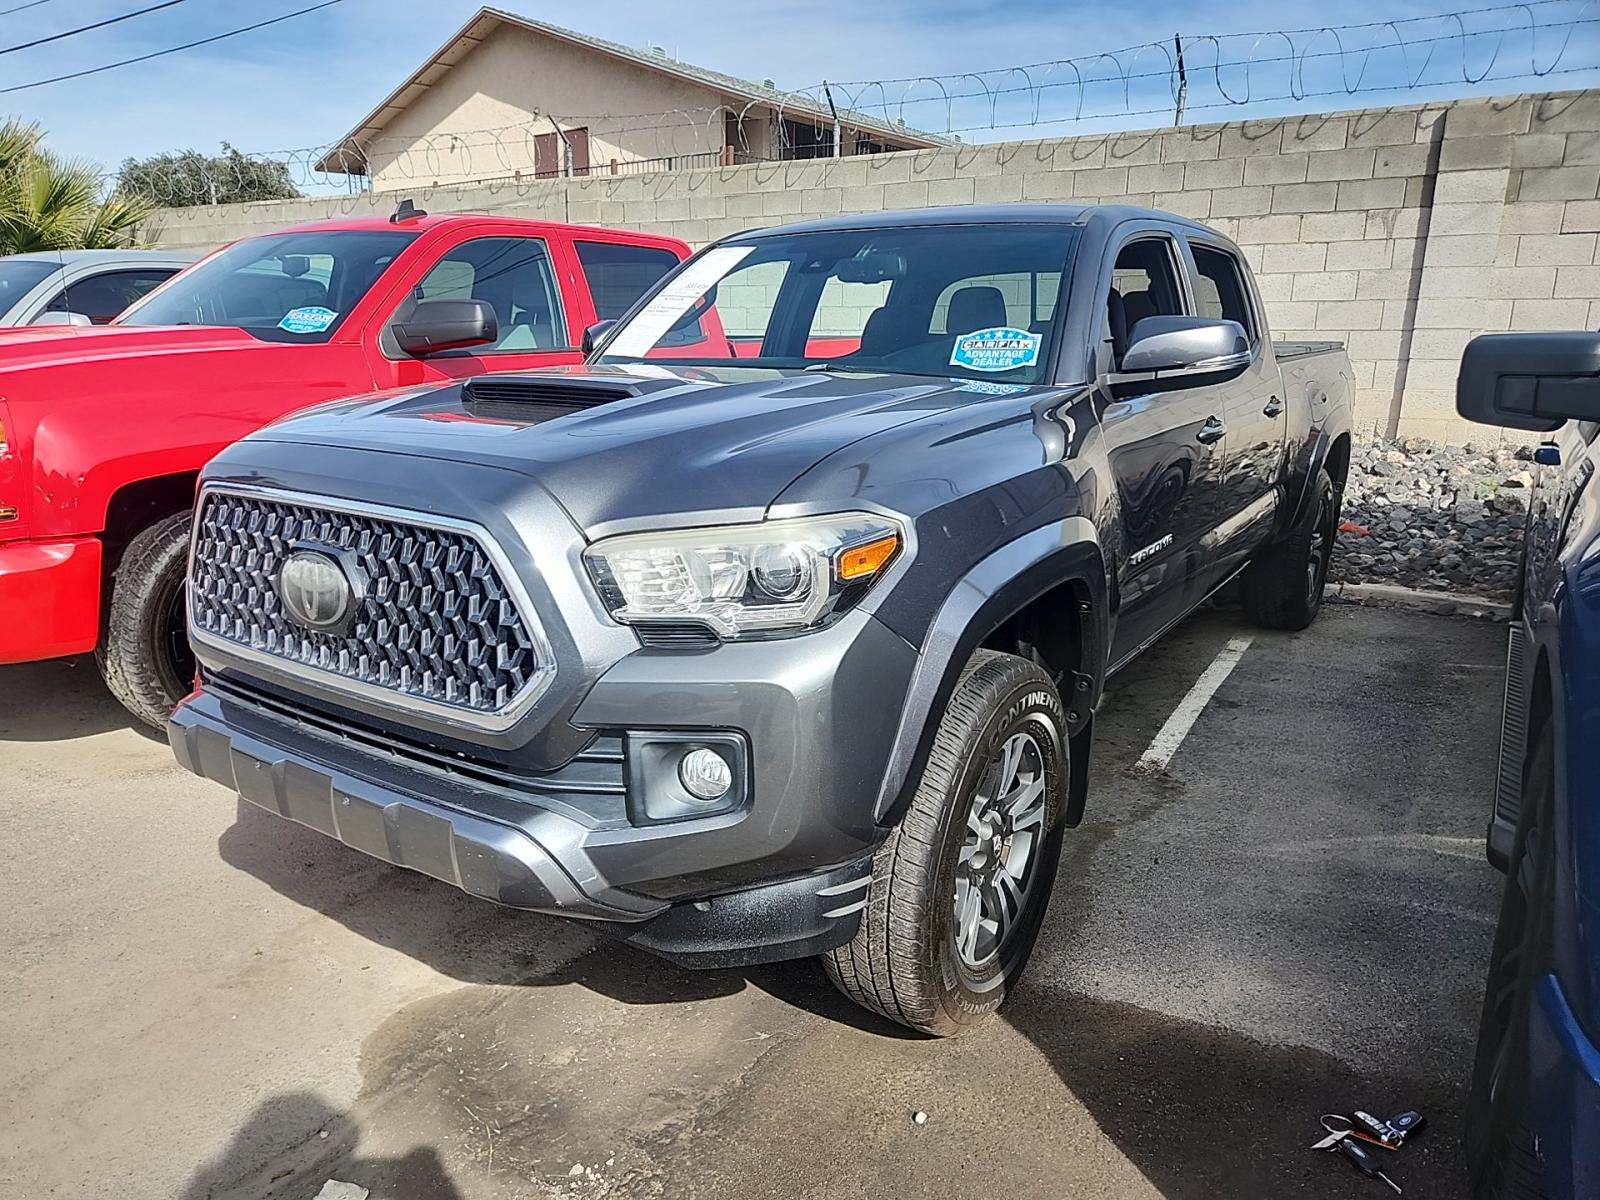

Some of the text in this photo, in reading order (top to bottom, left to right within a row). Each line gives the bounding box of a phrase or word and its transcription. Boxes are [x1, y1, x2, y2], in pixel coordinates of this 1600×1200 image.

[961, 340, 1031, 351] CARFAX
[964, 349, 1026, 359] ADVANTAGE
[972, 358, 1013, 366] DEALER
